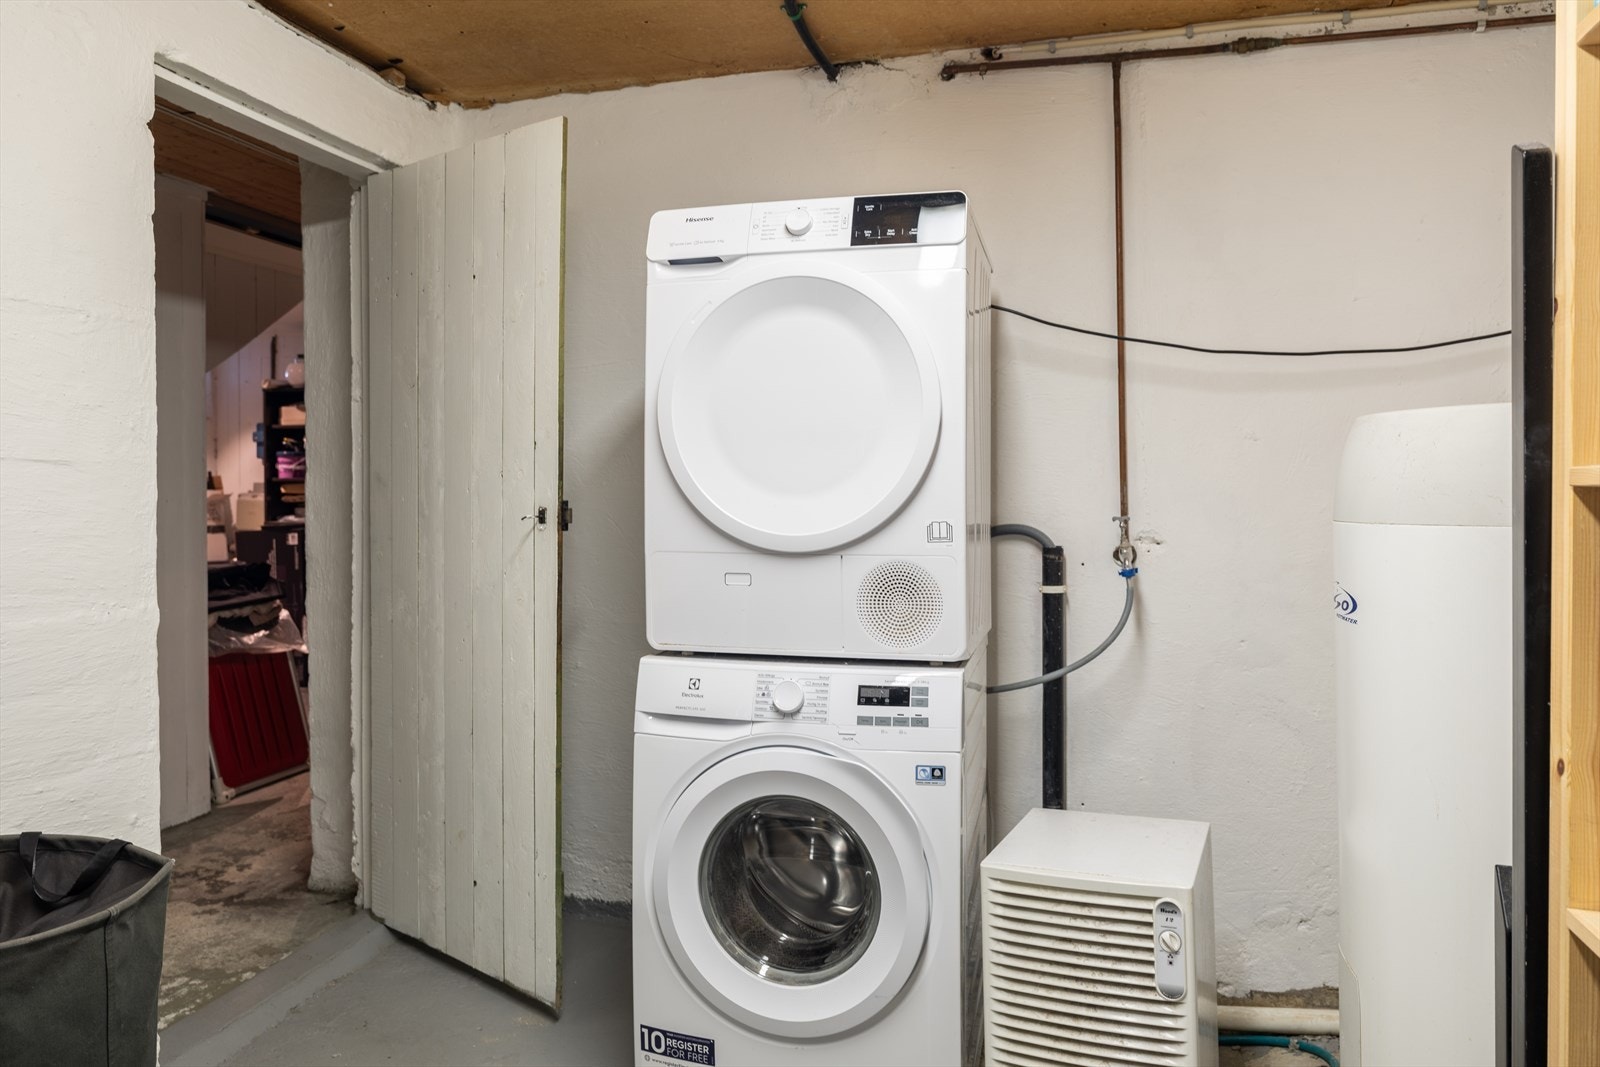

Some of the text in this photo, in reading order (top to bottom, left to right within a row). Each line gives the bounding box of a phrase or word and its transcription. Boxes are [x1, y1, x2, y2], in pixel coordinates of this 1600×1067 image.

[641, 1027, 666, 1053] 10
[666, 1038, 710, 1055] REGISTER
[666, 1047, 685, 1060] FOR
[687, 1052, 709, 1065] FREE
